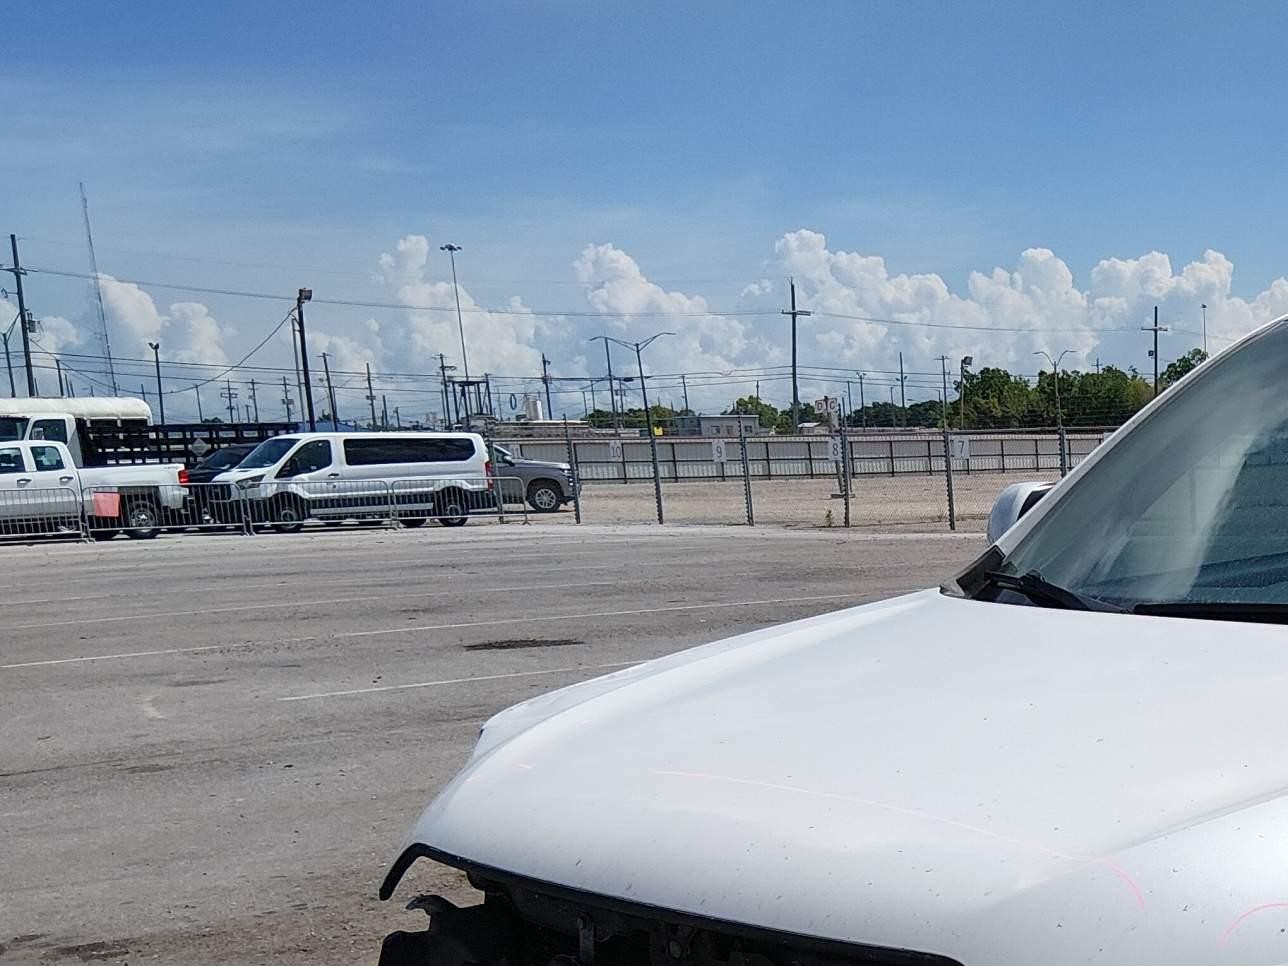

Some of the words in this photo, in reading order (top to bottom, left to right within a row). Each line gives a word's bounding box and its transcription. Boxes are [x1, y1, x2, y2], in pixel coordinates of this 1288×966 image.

[611, 446, 622, 458] 10
[716, 445, 723, 458] 9
[832, 443, 839, 457] 8
[958, 440, 965, 454] 7
